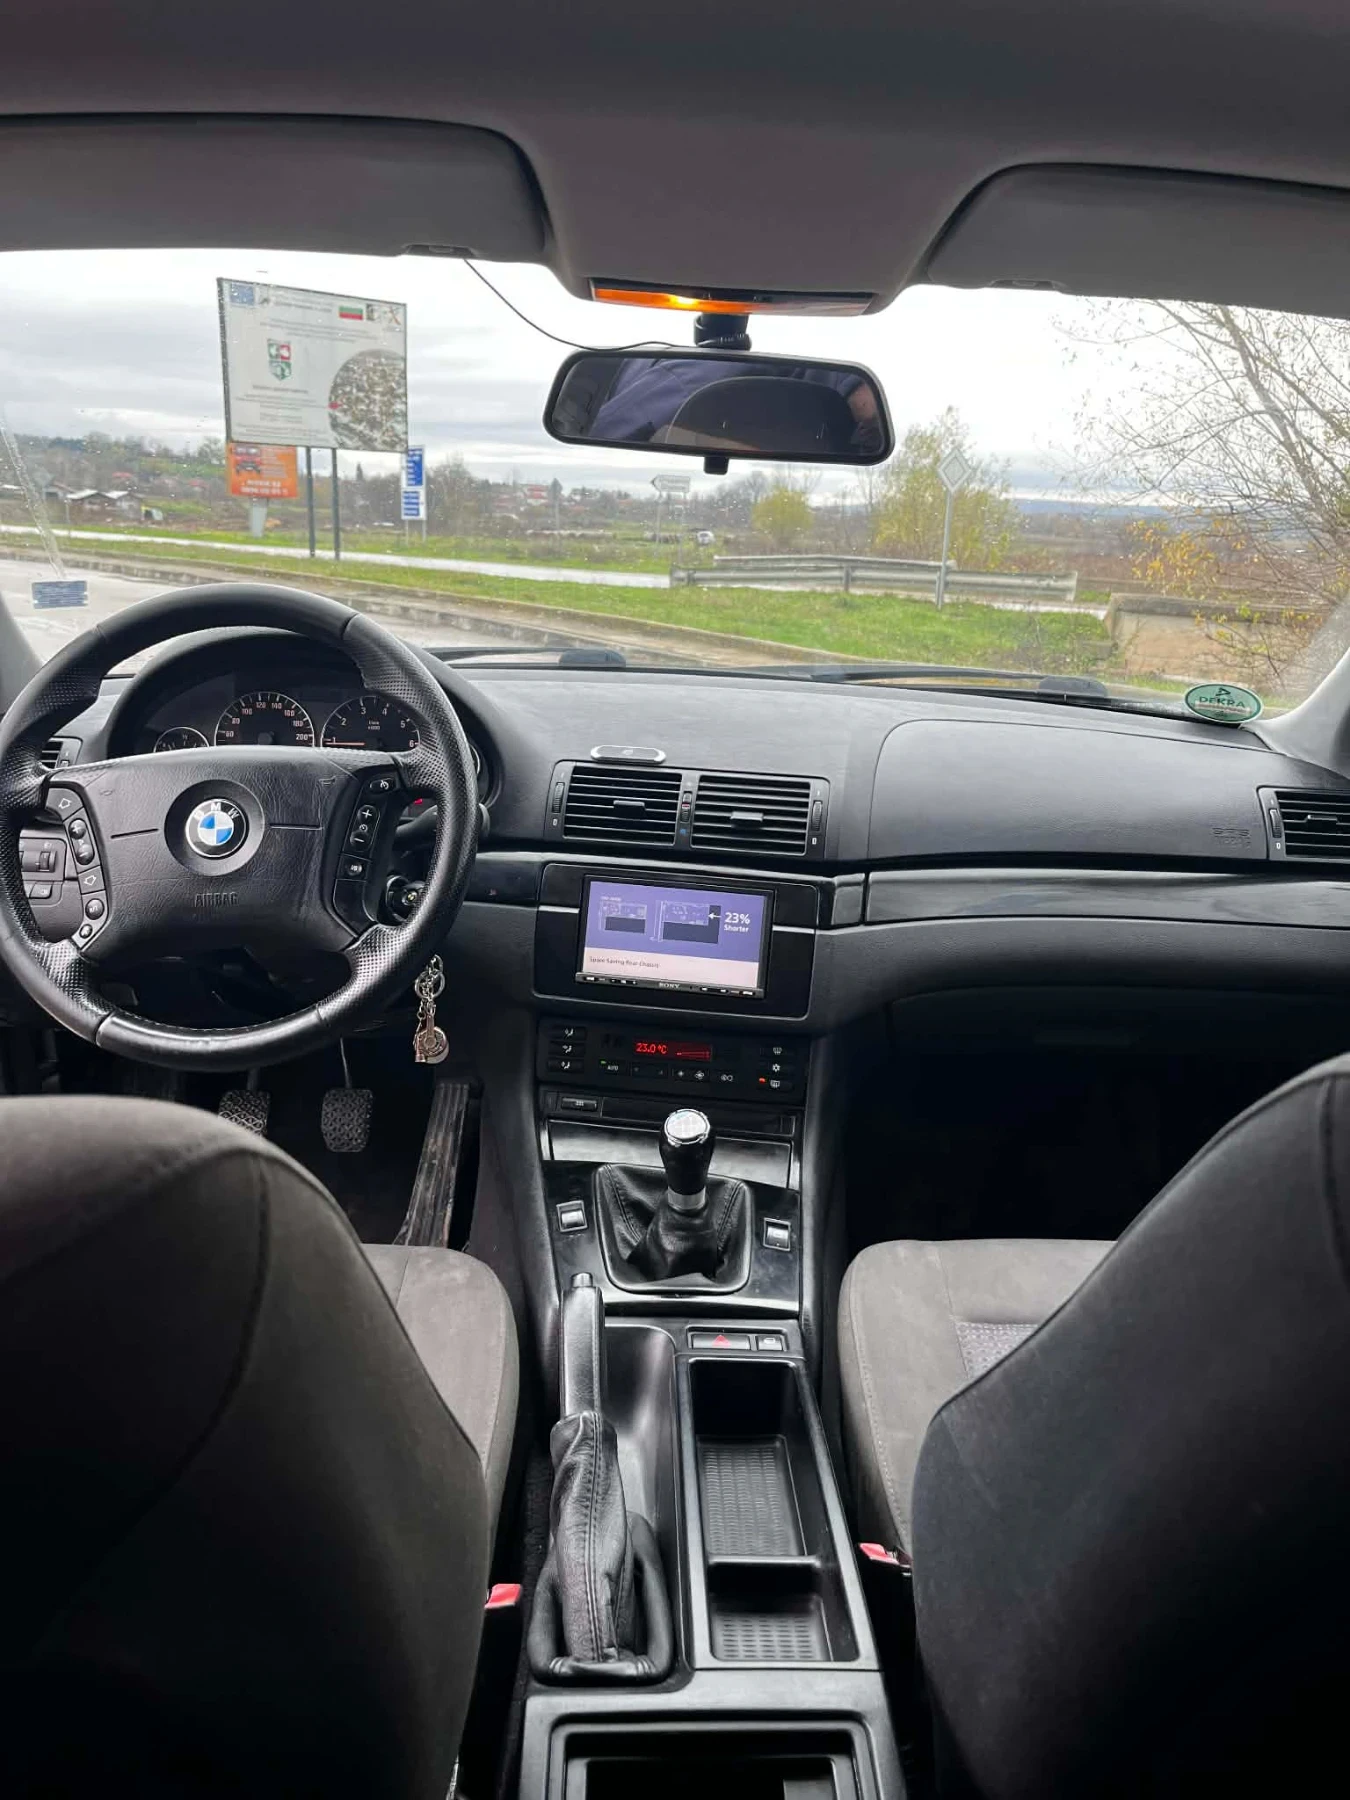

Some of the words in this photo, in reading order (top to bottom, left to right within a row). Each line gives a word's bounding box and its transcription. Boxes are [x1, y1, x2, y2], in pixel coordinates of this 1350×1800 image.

[256, 701, 266, 709] 120
[272, 702, 282, 710] 140
[1199, 696, 1245, 708] DEKRA
[360, 707, 366, 715] 3
[382, 707, 388, 716] 4
[341, 717, 347, 726] 2
[400, 720, 406, 728] 5
[295, 733, 308, 741] 200
[408, 739, 414, 748] 6
[193, 801, 240, 821] BMW
[194, 891, 240, 908] AIRBAG
[724, 911, 750, 925] 23%
[723, 924, 749, 933] Shorter
[635, 1042, 656, 1054] 23.0
